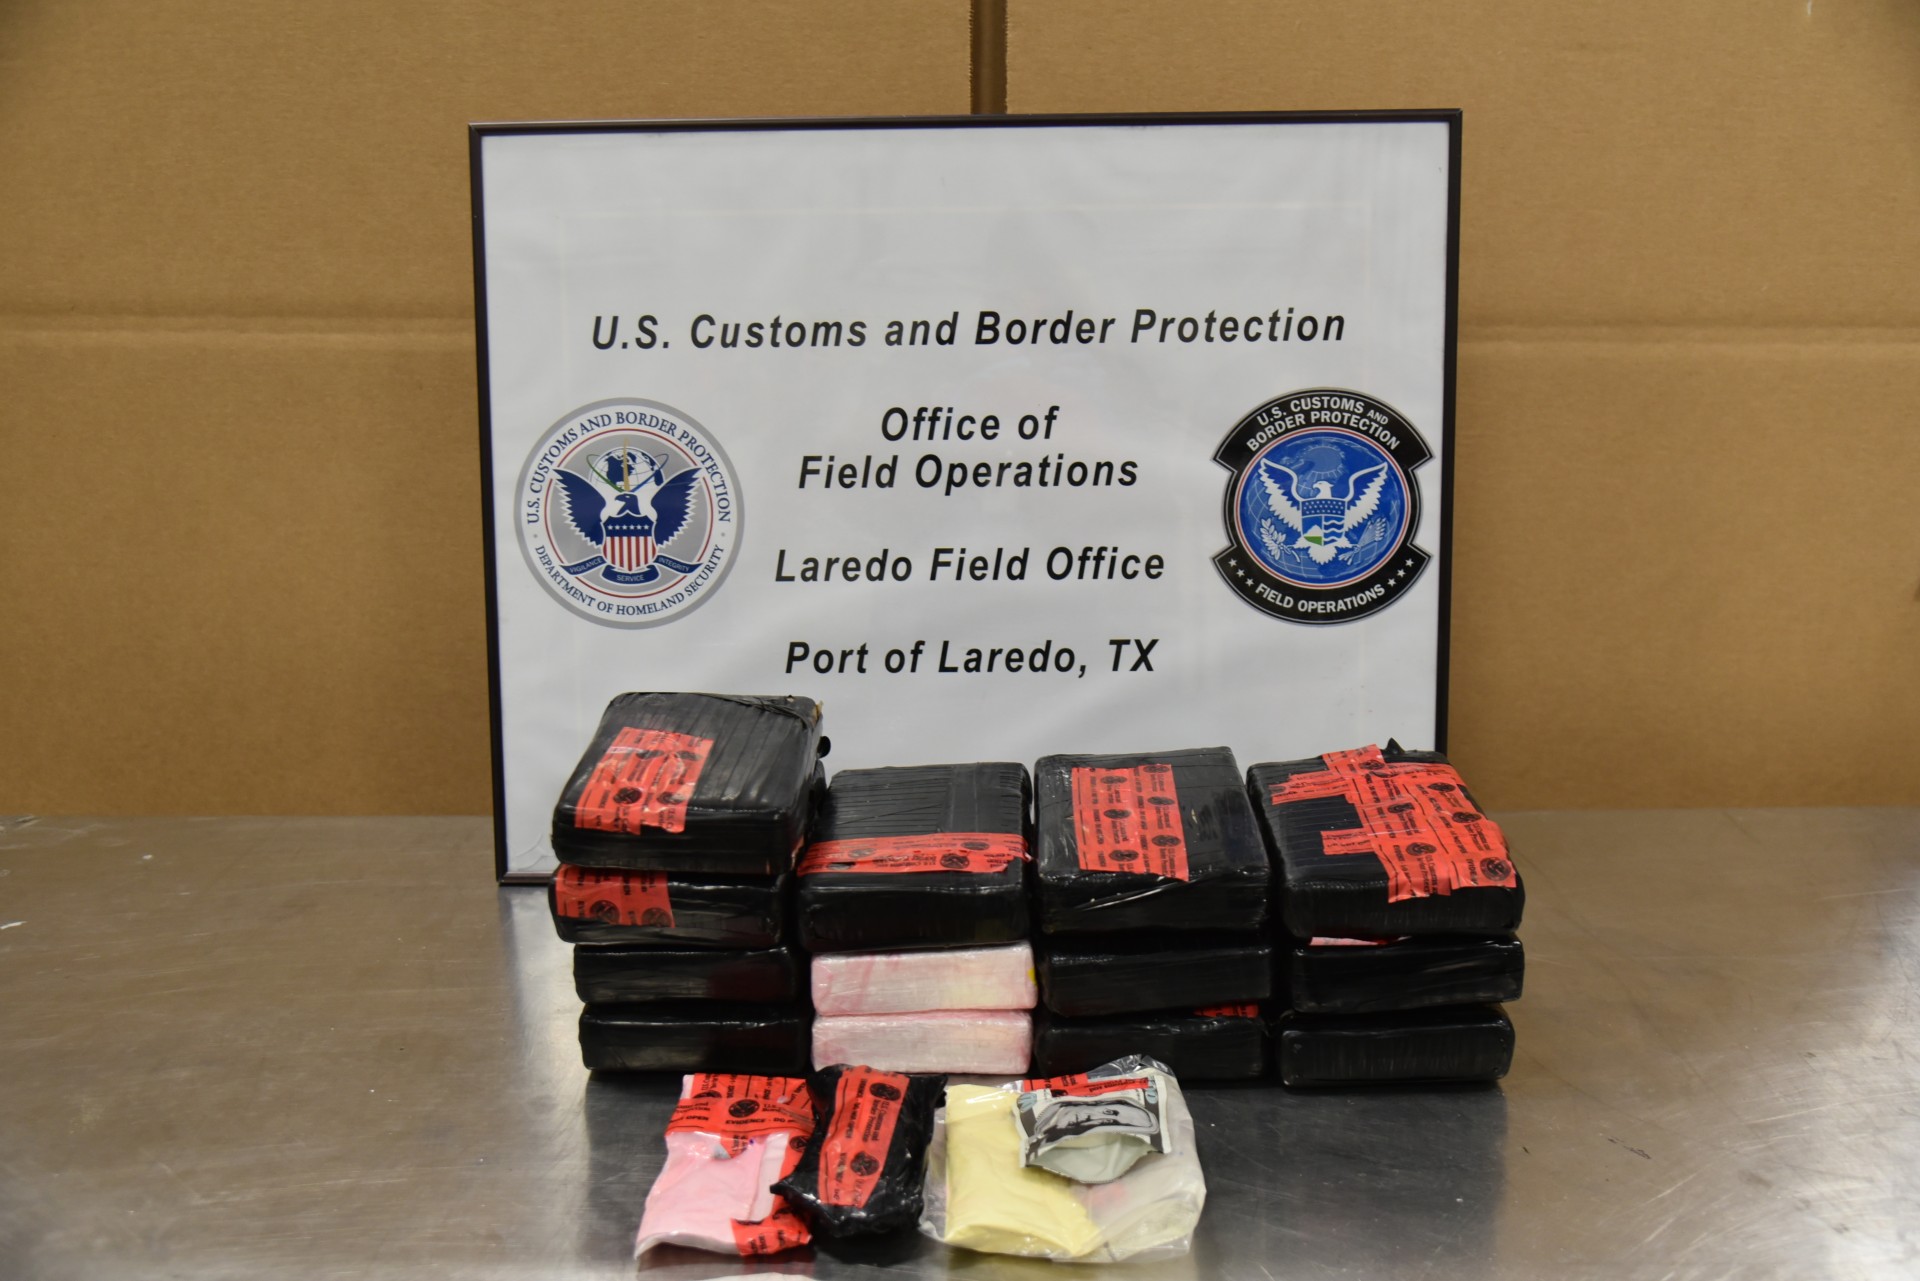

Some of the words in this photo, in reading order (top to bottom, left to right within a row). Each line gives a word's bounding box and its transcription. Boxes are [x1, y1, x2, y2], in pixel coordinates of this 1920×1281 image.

[592, 314, 669, 350] U.S.
[690, 314, 867, 349] Customs
[884, 311, 959, 347] and
[974, 309, 1116, 345] Border
[1130, 307, 1345, 344] Protection
[580, 413, 613, 435] AND
[615, 411, 677, 438] BORDER
[881, 406, 1000, 442] Office
[1017, 405, 1060, 441] of
[1246, 413, 1306, 452] BORDER
[1310, 410, 1401, 450] PROTECTION
[1256, 406, 1287, 428] U.S.
[1290, 396, 1364, 414] CUSTOMS
[1366, 409, 1389, 426] AND
[529, 427, 579, 494] CUSTOMS
[676, 428, 731, 523] PROTECTION
[798, 454, 899, 489] Field
[915, 453, 1138, 497] Operations
[527, 498, 541, 525] U.S.
[534, 545, 596, 607] DEPARTMENT
[596, 600, 614, 614] OF
[615, 591, 685, 616] HOMELAND
[684, 544, 725, 597] SECURITY
[616, 574, 645, 583] SERVICE
[775, 548, 912, 583] Laredo
[929, 547, 1030, 582] Field
[1046, 545, 1165, 581] Office
[1255, 582, 1295, 609] FIELD
[1297, 583, 1386, 614] OPERATIONS
[785, 641, 869, 674] Port
[884, 639, 926, 674] of
[938, 639, 1087, 679] Laredo,
[1108, 638, 1159, 672] TX
